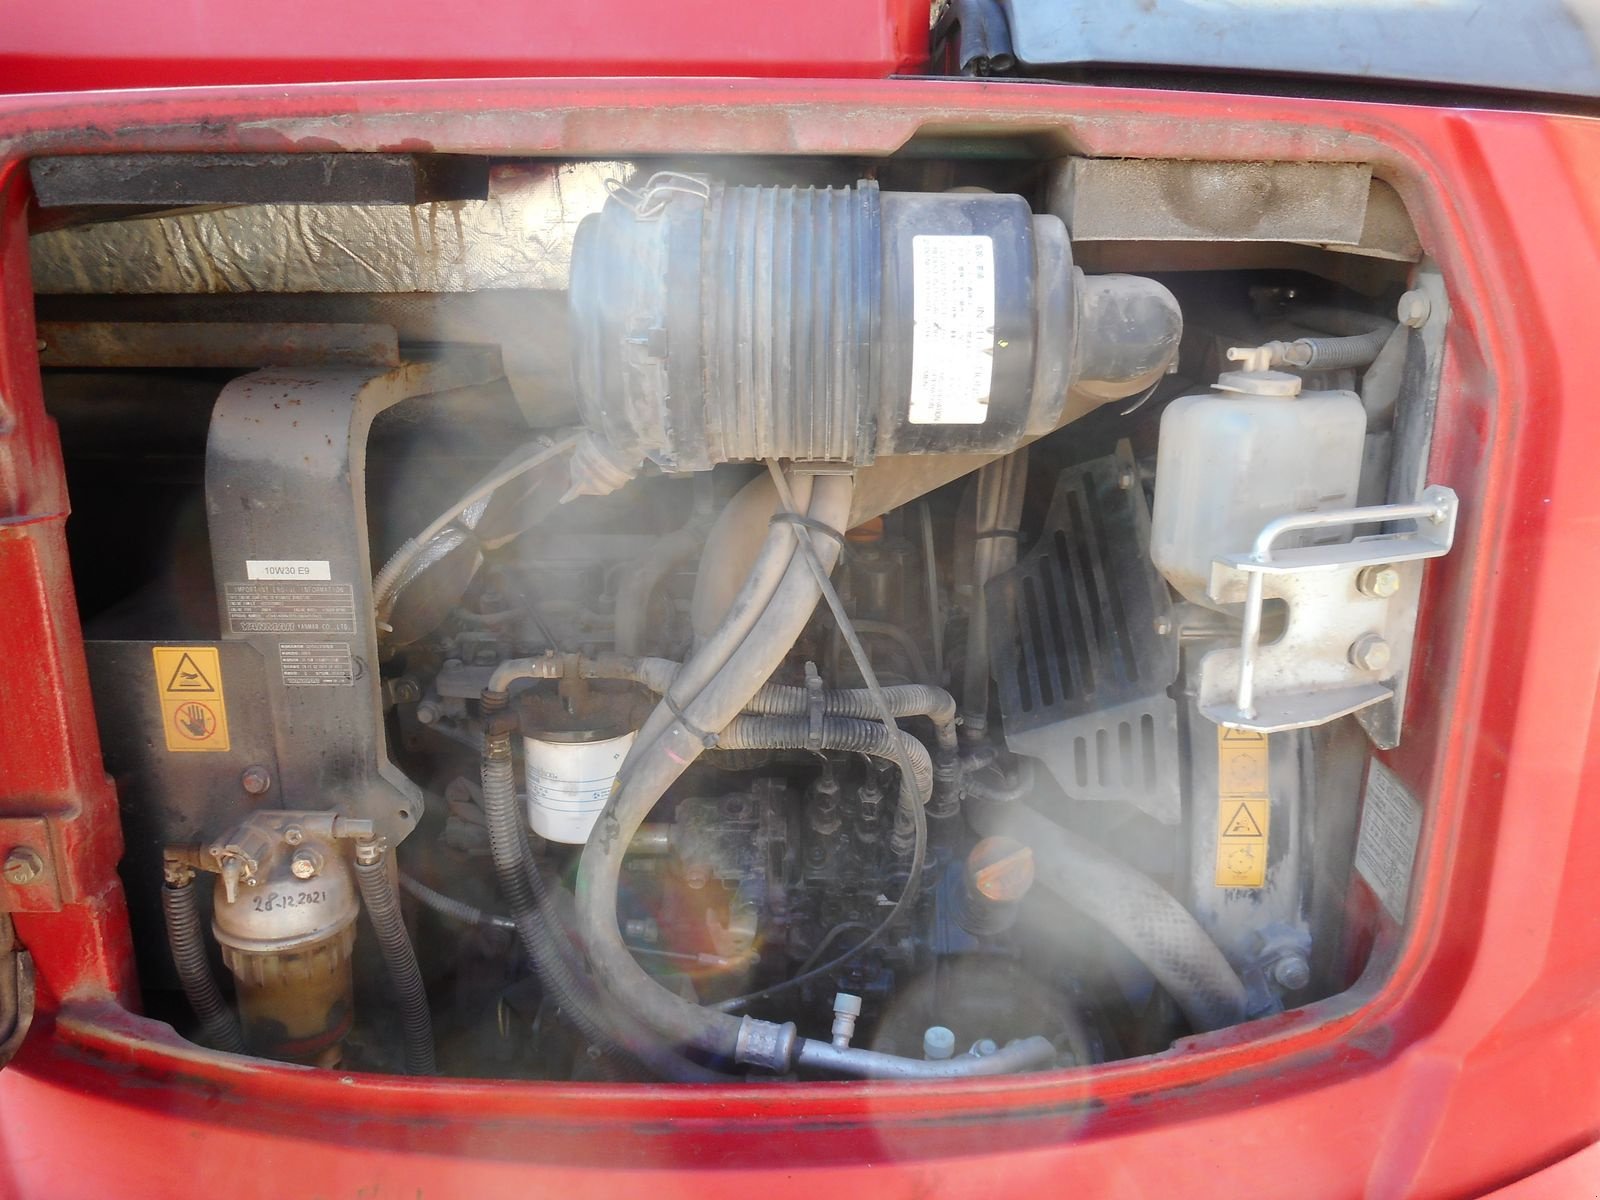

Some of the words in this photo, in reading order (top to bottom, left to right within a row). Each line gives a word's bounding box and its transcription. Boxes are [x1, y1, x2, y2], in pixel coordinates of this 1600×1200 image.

[265, 566, 296, 575] 10W30
[298, 566, 310, 575] E9
[240, 622, 295, 632] YANMAR
